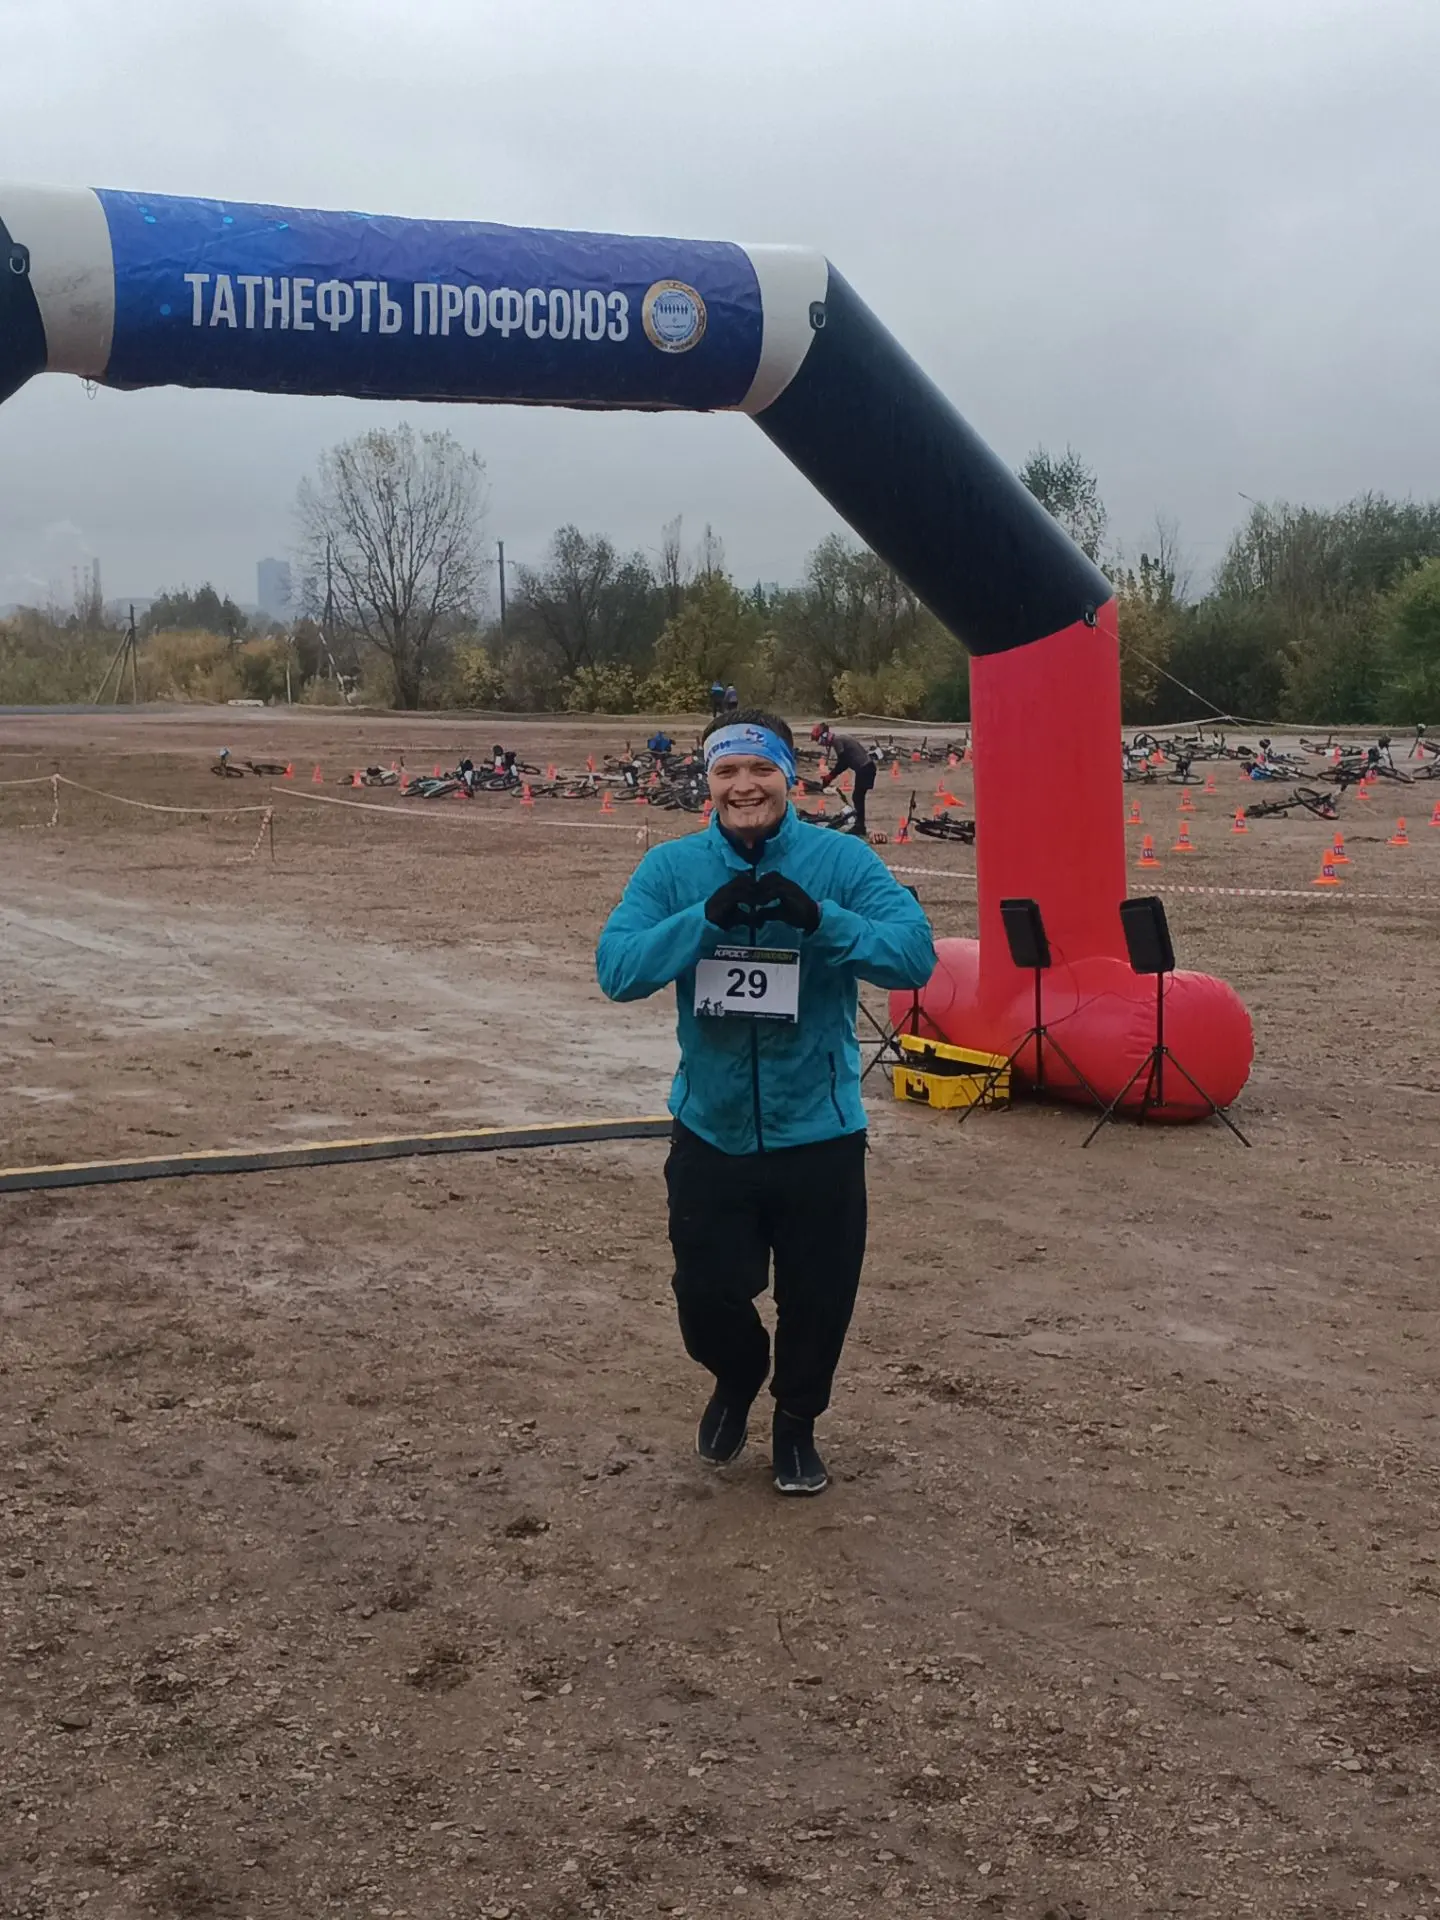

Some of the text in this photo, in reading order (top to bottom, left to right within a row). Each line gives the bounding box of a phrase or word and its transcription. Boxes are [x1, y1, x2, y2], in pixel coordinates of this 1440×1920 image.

[183, 272, 403, 334] ТАТНЕФТЬ
[413, 282, 630, 342] ПРОФСОЮЗ
[726, 967, 768, 999] 29
